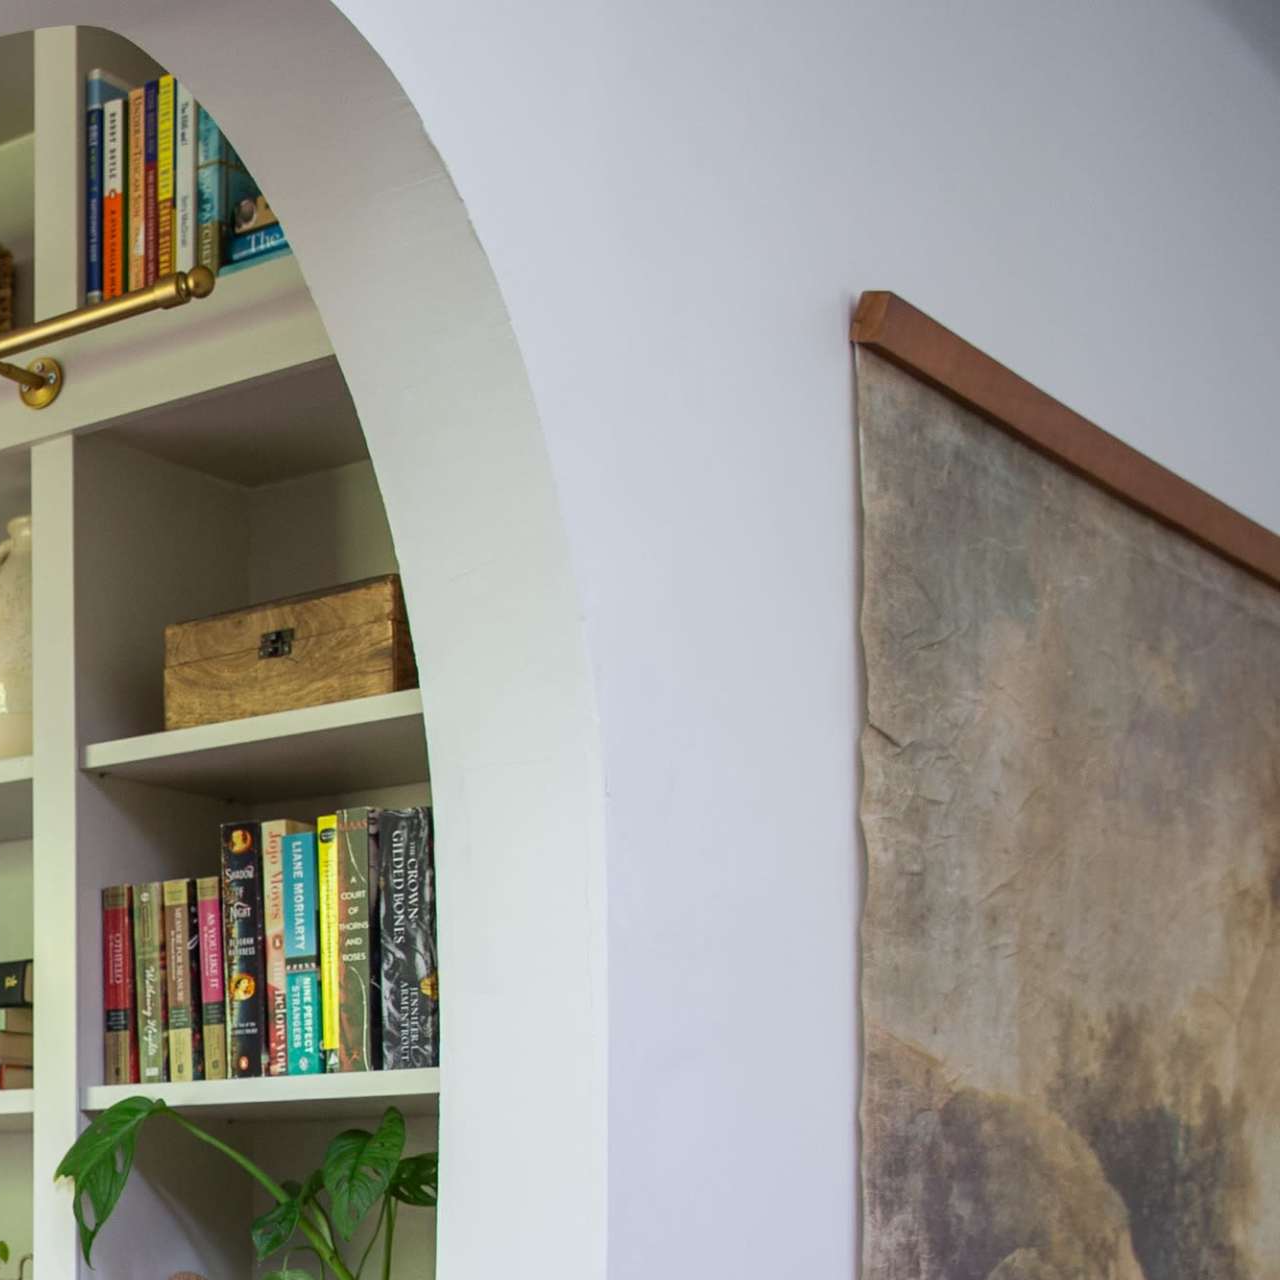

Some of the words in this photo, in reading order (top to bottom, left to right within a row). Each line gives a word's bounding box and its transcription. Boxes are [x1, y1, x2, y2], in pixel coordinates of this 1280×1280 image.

[266, 832, 281, 864] Jojo
[292, 841, 304, 879] LIANE
[392, 830, 404, 890] GILDED
[225, 865, 255, 881] SHADOW
[271, 872, 283, 920] Moyes
[340, 890, 366, 900] COURT
[408, 859, 419, 919] CROWN
[207, 912, 216, 926] AS
[230, 902, 252, 922] NIGHT
[294, 883, 306, 951] MORIARTY
[348, 906, 359, 915] OF
[393, 893, 405, 944] BONES
[208, 927, 217, 951] YOU
[339, 921, 369, 931] THORNS
[344, 937, 362, 946] AND
[113, 932, 123, 984] OTHELLO
[210, 953, 218, 976] LIKE
[343, 953, 367, 962] ROSES
[211, 977, 219, 990] IT
[303, 976, 313, 1003] NINE
[274, 990, 287, 1040] before
[291, 984, 302, 1048] STRANGERS
[400, 980, 410, 1061] ARMENTROUT
[410, 986, 419, 1041] JENNIFER
[303, 1006, 314, 1054] PERFECT
[276, 1044, 288, 1073] you
